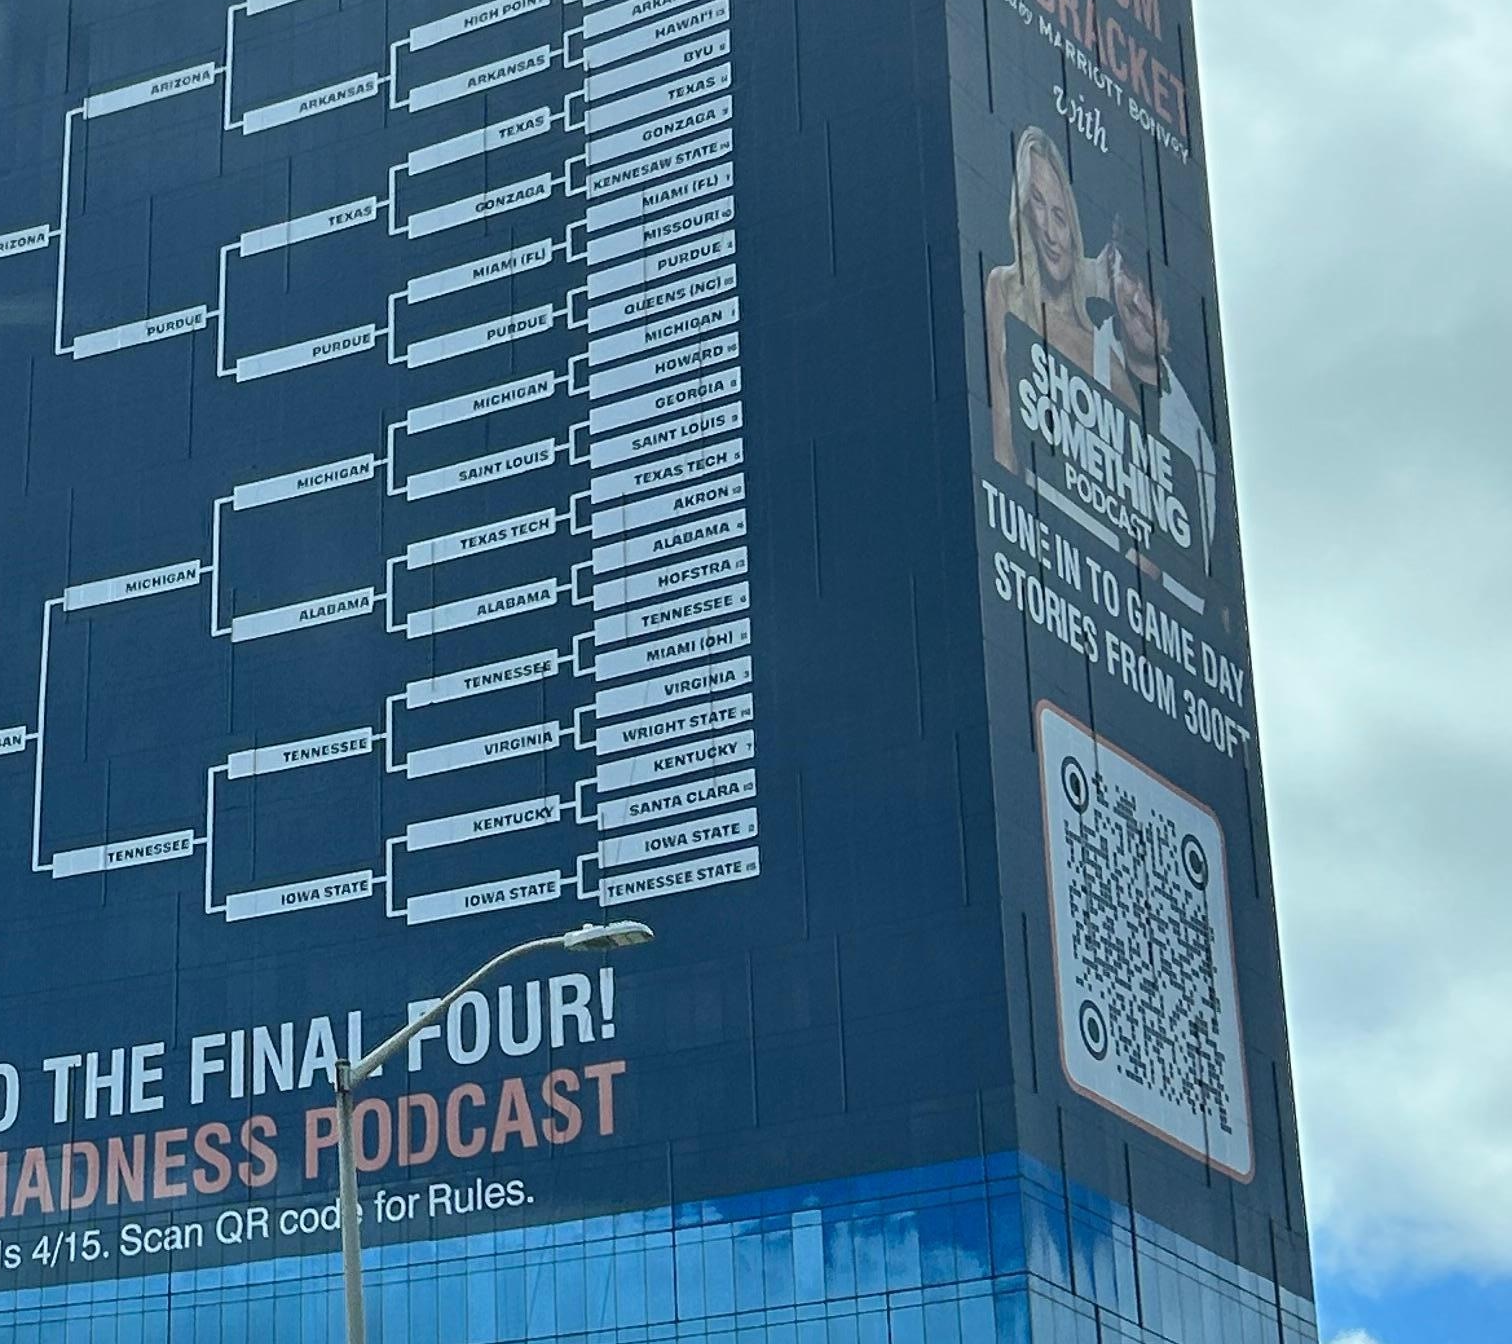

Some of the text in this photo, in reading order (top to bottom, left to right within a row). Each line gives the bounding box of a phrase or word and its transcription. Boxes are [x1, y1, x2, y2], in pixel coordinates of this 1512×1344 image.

[463, 10, 500, 29] HIGH
[150, 69, 212, 94] ARIZONA
[642, 112, 717, 142] GONZAGA
[327, 206, 373, 228] TEXAS
[643, 209, 720, 242] MISSOURI
[147, 313, 203, 336] PURDUE
[312, 333, 371, 357] PURDUE
[655, 343, 724, 374] HOWARD
[654, 380, 725, 409] GEORGIA
[1031, 343, 1174, 494] SHOW ME
[296, 462, 370, 489] MICHIGAN
[459, 450, 549, 483] SAINT LOUIS
[1018, 378, 1192, 549] SOMETHING
[673, 486, 729, 512] AKRON
[1065, 462, 1153, 549] PODCAST
[460, 518, 550, 550] TEXAS TECH
[125, 568, 196, 593] MICHIGAN
[657, 559, 731, 588] HOFSTRA
[982, 479, 1245, 708] TUNE IN TO GAME DAY
[994, 551, 1253, 760] STORIES FROM 300FT
[622, 707, 736, 743] WRIGHT STATE
[282, 737, 368, 762] TENNESSEE
[484, 730, 553, 755] VIRGINIA
[628, 781, 739, 816] SANTA CLARA
[473, 805, 554, 833] KENTUCKY
[107, 838, 190, 863] TENNESSEE
[281, 880, 368, 906] IOWA STATE
[607, 861, 742, 898] TENNESSEE STATE
[44, 1041, 165, 1125] THE
[191, 1011, 384, 1105] FINAL
[408, 967, 617, 1073] FOUR!
[306, 1061, 627, 1180] PODCAST
[31, 1230, 110, 1269] 4/15.
[120, 1220, 204, 1257] Scan
[216, 1208, 272, 1245] QR
[280, 1198, 363, 1235] cod
[375, 1192, 424, 1223] for
[428, 1178, 535, 1217] Rules.
